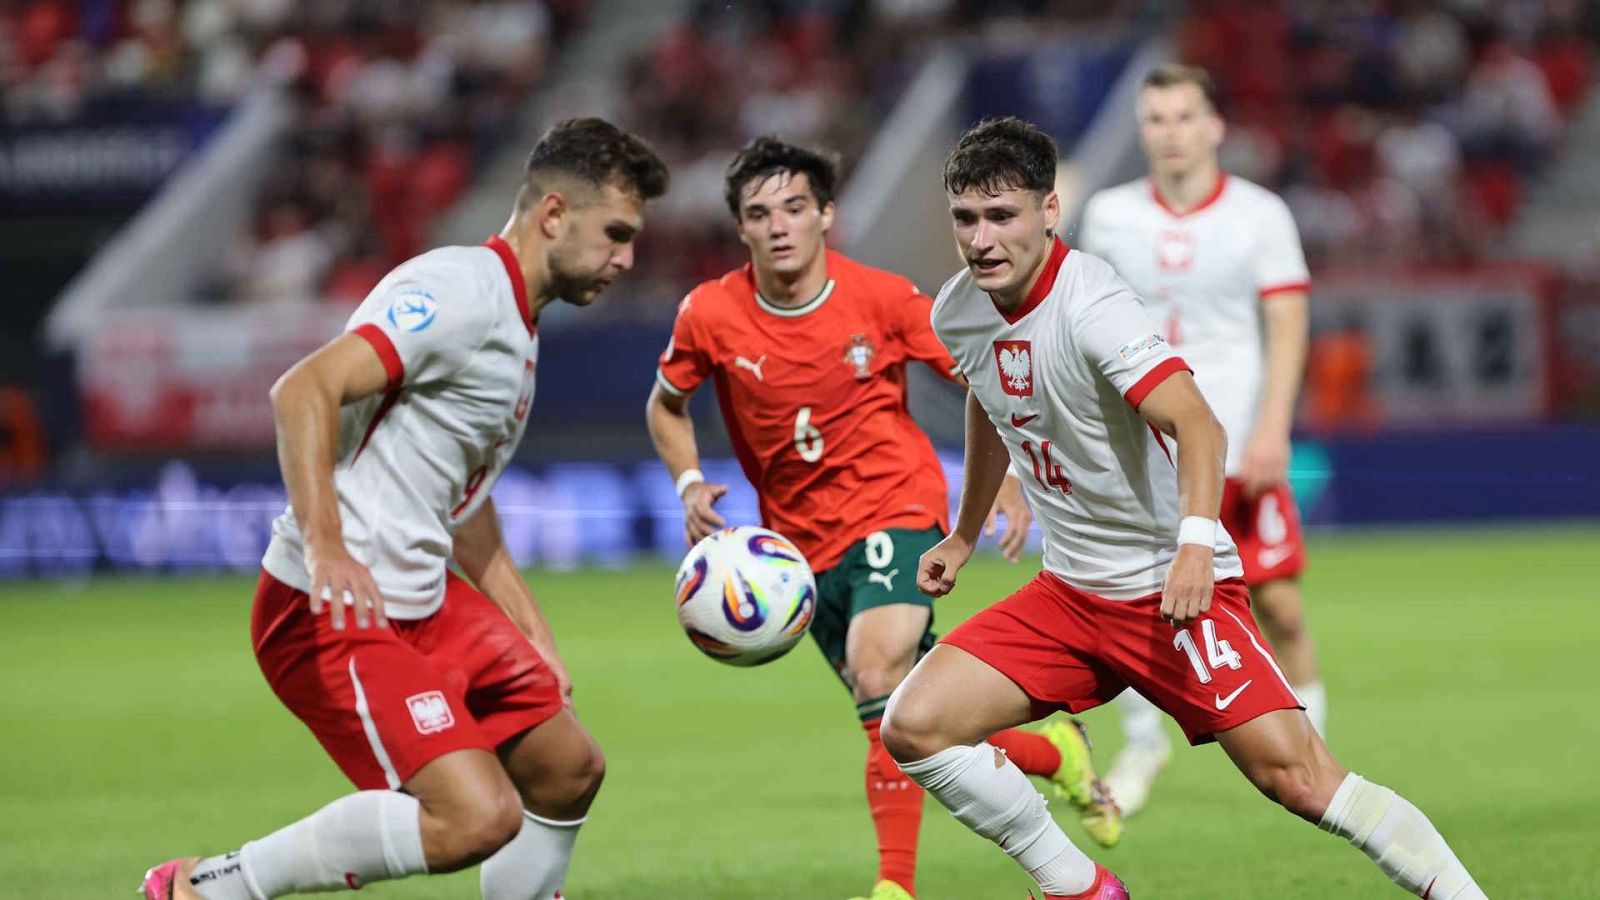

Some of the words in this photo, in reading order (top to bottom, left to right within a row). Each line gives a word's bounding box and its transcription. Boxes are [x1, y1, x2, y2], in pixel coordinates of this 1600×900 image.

[794, 407, 824, 462] 6
[451, 465, 488, 519] 9
[1021, 441, 1072, 495] 14
[1173, 618, 1242, 684] 14
